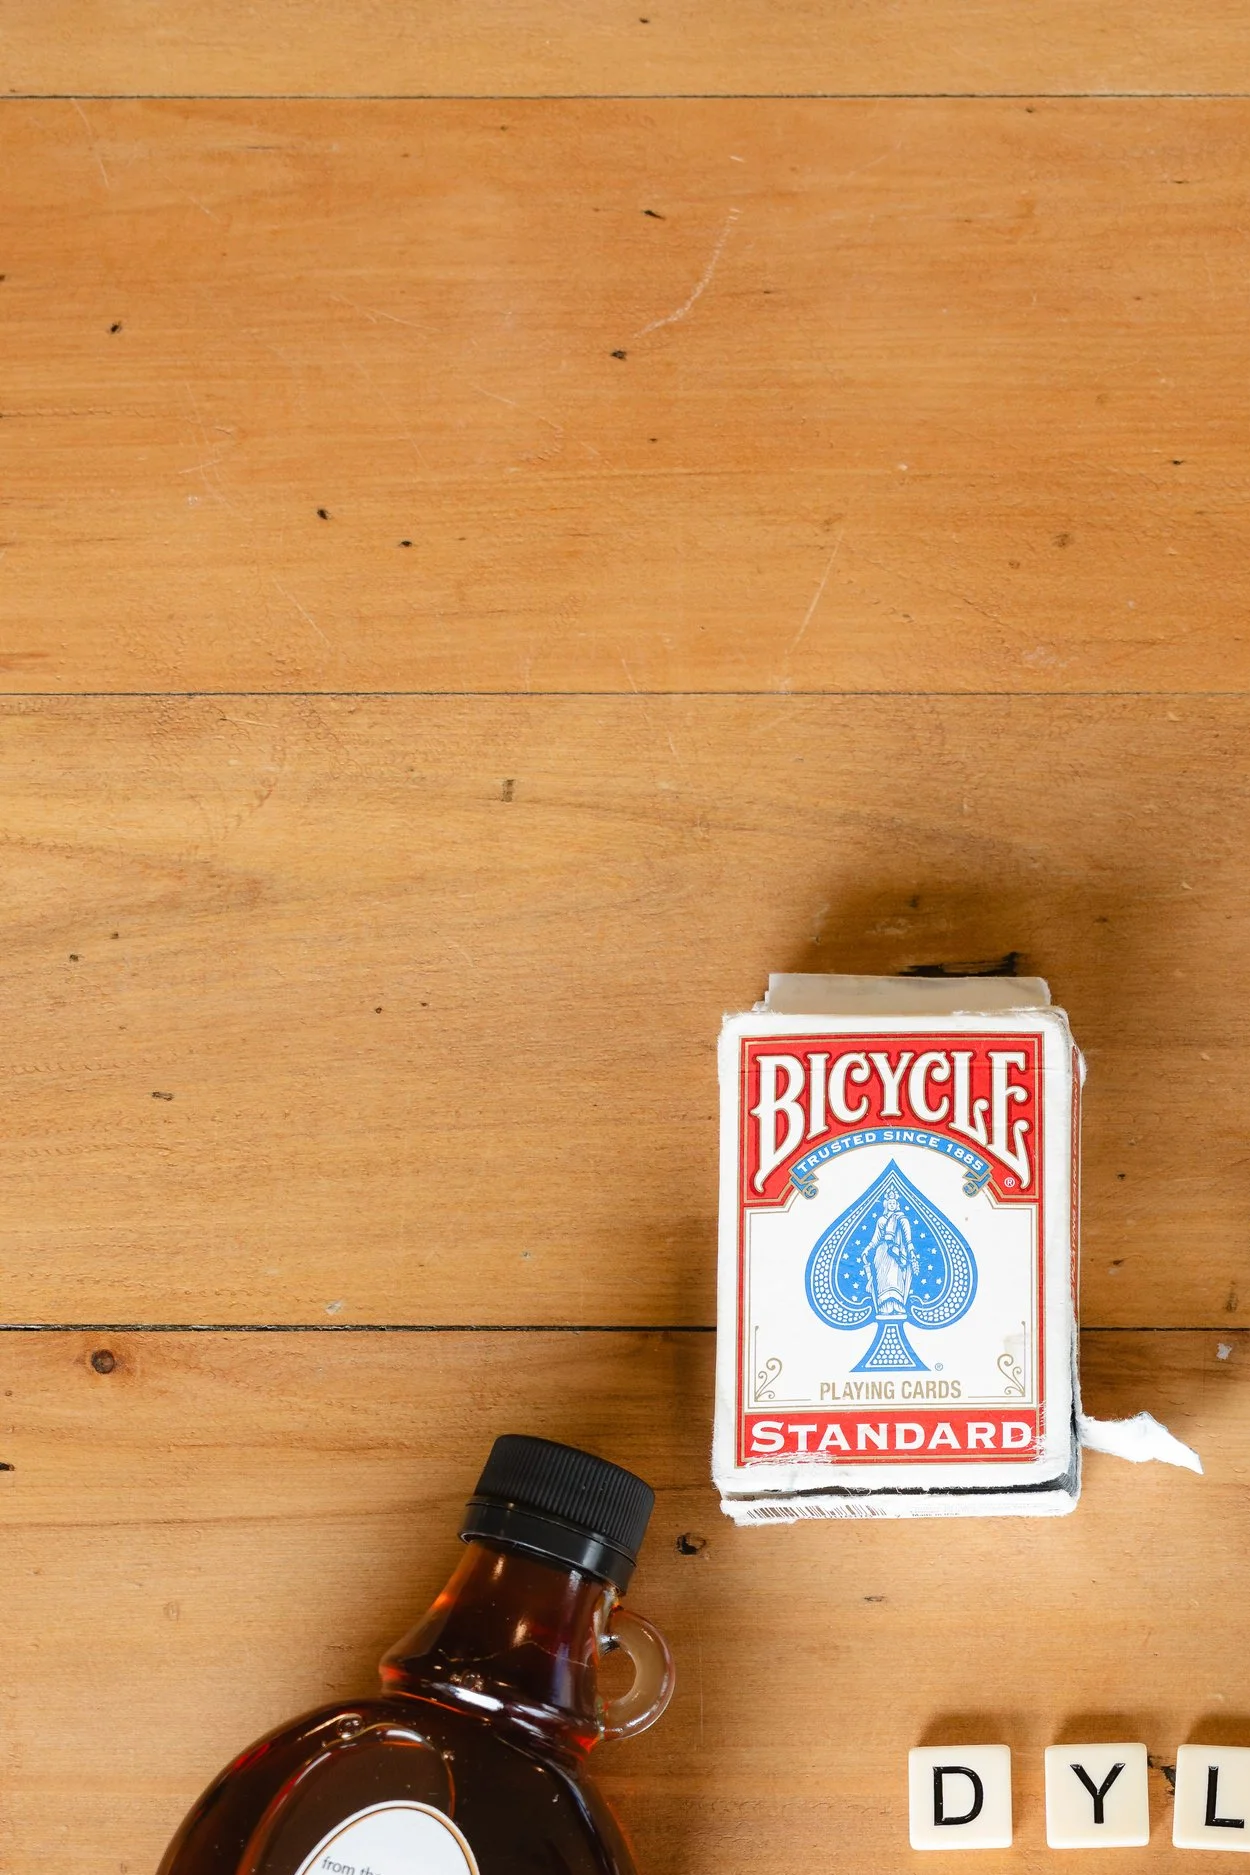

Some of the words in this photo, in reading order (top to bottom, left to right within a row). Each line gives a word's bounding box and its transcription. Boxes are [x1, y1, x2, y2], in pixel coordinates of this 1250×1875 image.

[751, 1051, 1031, 1195] BICYCLE
[797, 1131, 876, 1174] TRUSTED
[883, 1131, 940, 1148] SINCE
[946, 1143, 985, 1172] 1885
[820, 1381, 895, 1401] PLAYING
[901, 1380, 962, 1399] CARDS
[750, 1420, 1033, 1453] STANDARD
